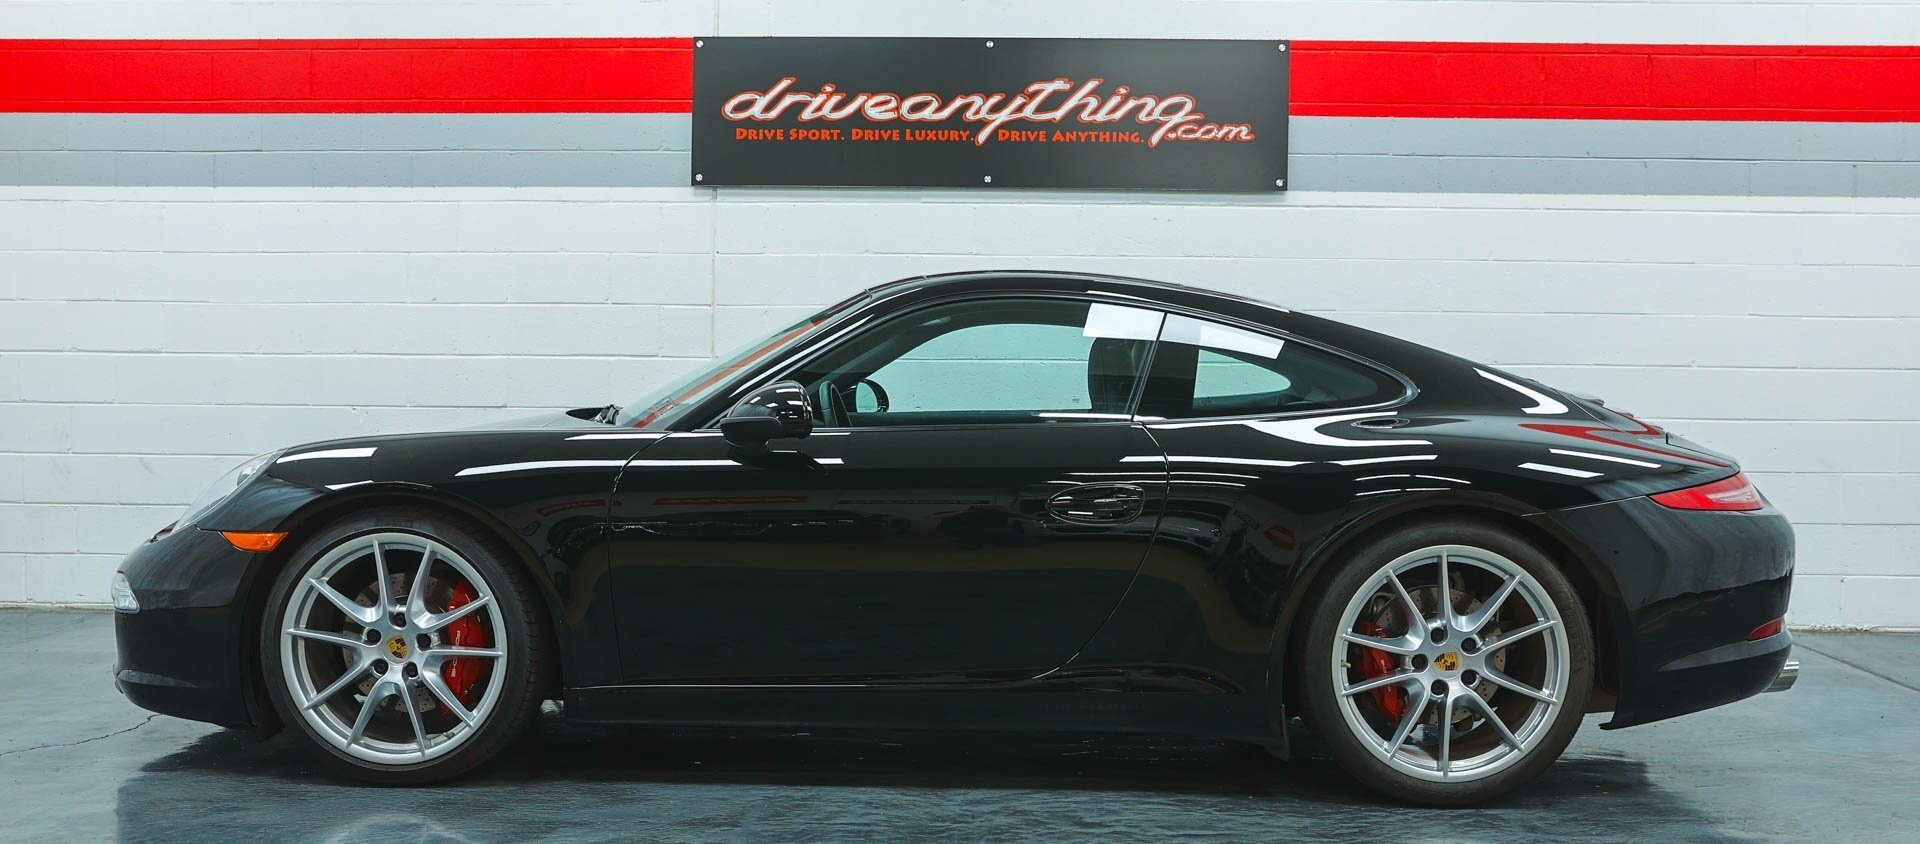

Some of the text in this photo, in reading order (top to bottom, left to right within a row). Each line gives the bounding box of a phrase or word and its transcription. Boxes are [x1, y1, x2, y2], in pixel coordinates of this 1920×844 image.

[735, 128, 1145, 144] DRIVE SPORT. DRIVE LUXURY. DRIVE ANYTHING.
[451, 630, 461, 678] POCHE
